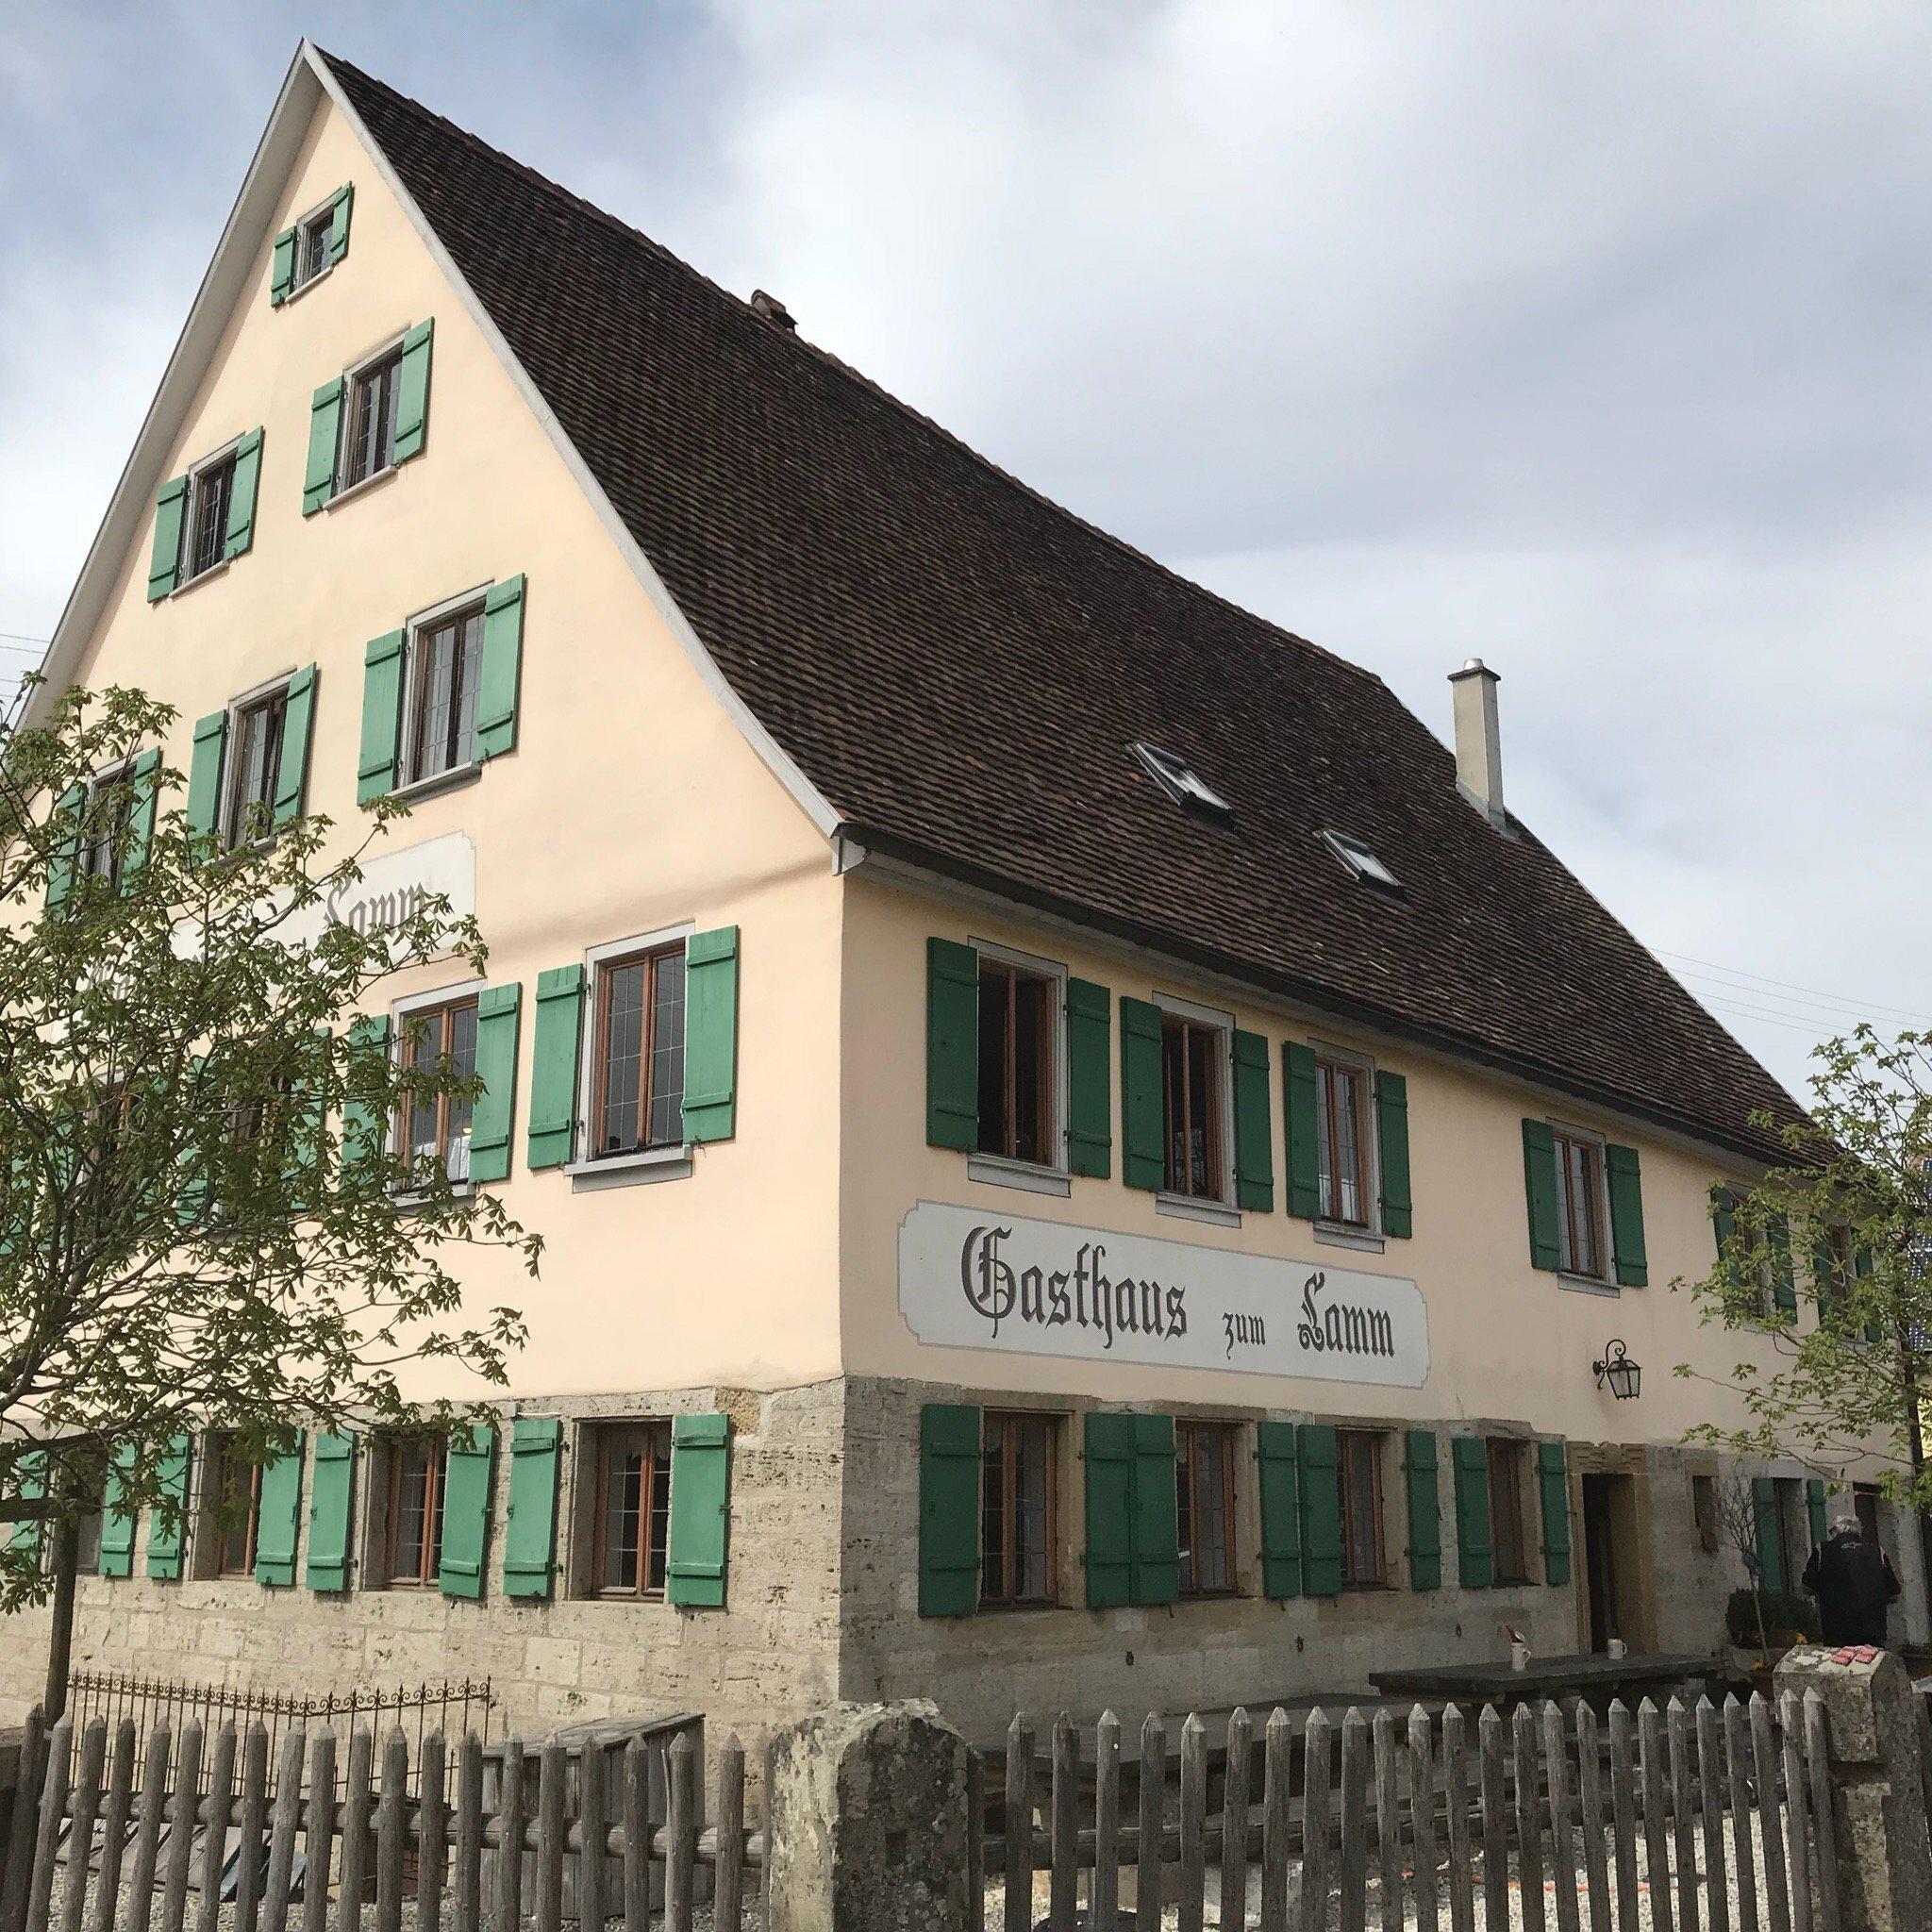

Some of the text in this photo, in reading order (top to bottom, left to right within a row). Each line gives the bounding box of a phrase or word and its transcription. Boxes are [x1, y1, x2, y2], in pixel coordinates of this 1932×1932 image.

[961, 1225, 1395, 1361] Gasthaus zum Lamm
